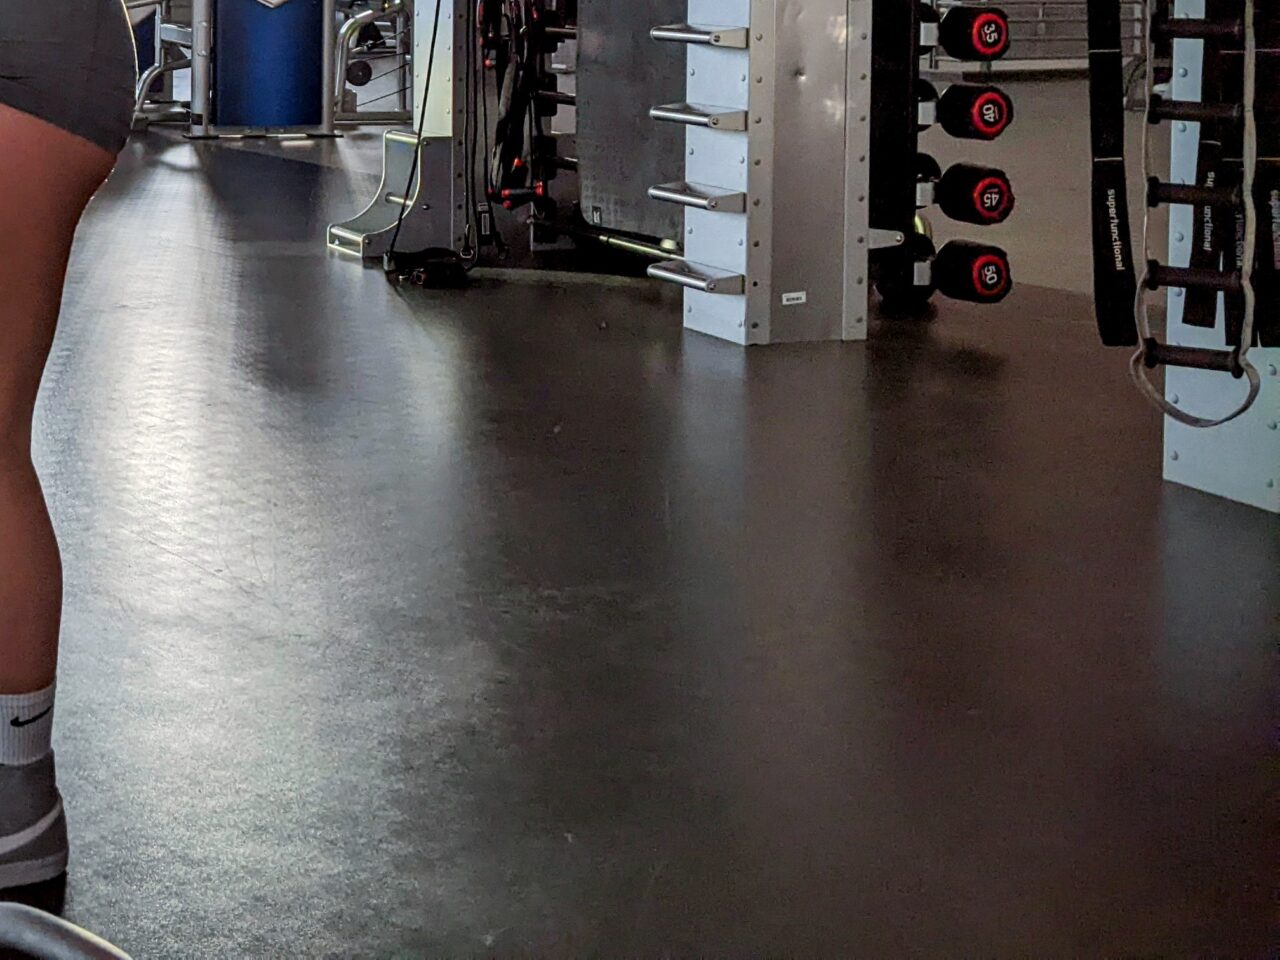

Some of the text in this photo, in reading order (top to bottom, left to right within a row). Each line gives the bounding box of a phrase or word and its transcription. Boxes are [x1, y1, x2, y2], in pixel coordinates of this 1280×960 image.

[984, 23, 998, 43] 35
[982, 103, 996, 122] 40
[983, 193, 1000, 208] 45
[1106, 189, 1125, 271] superfunctional
[984, 265, 997, 284] 50
